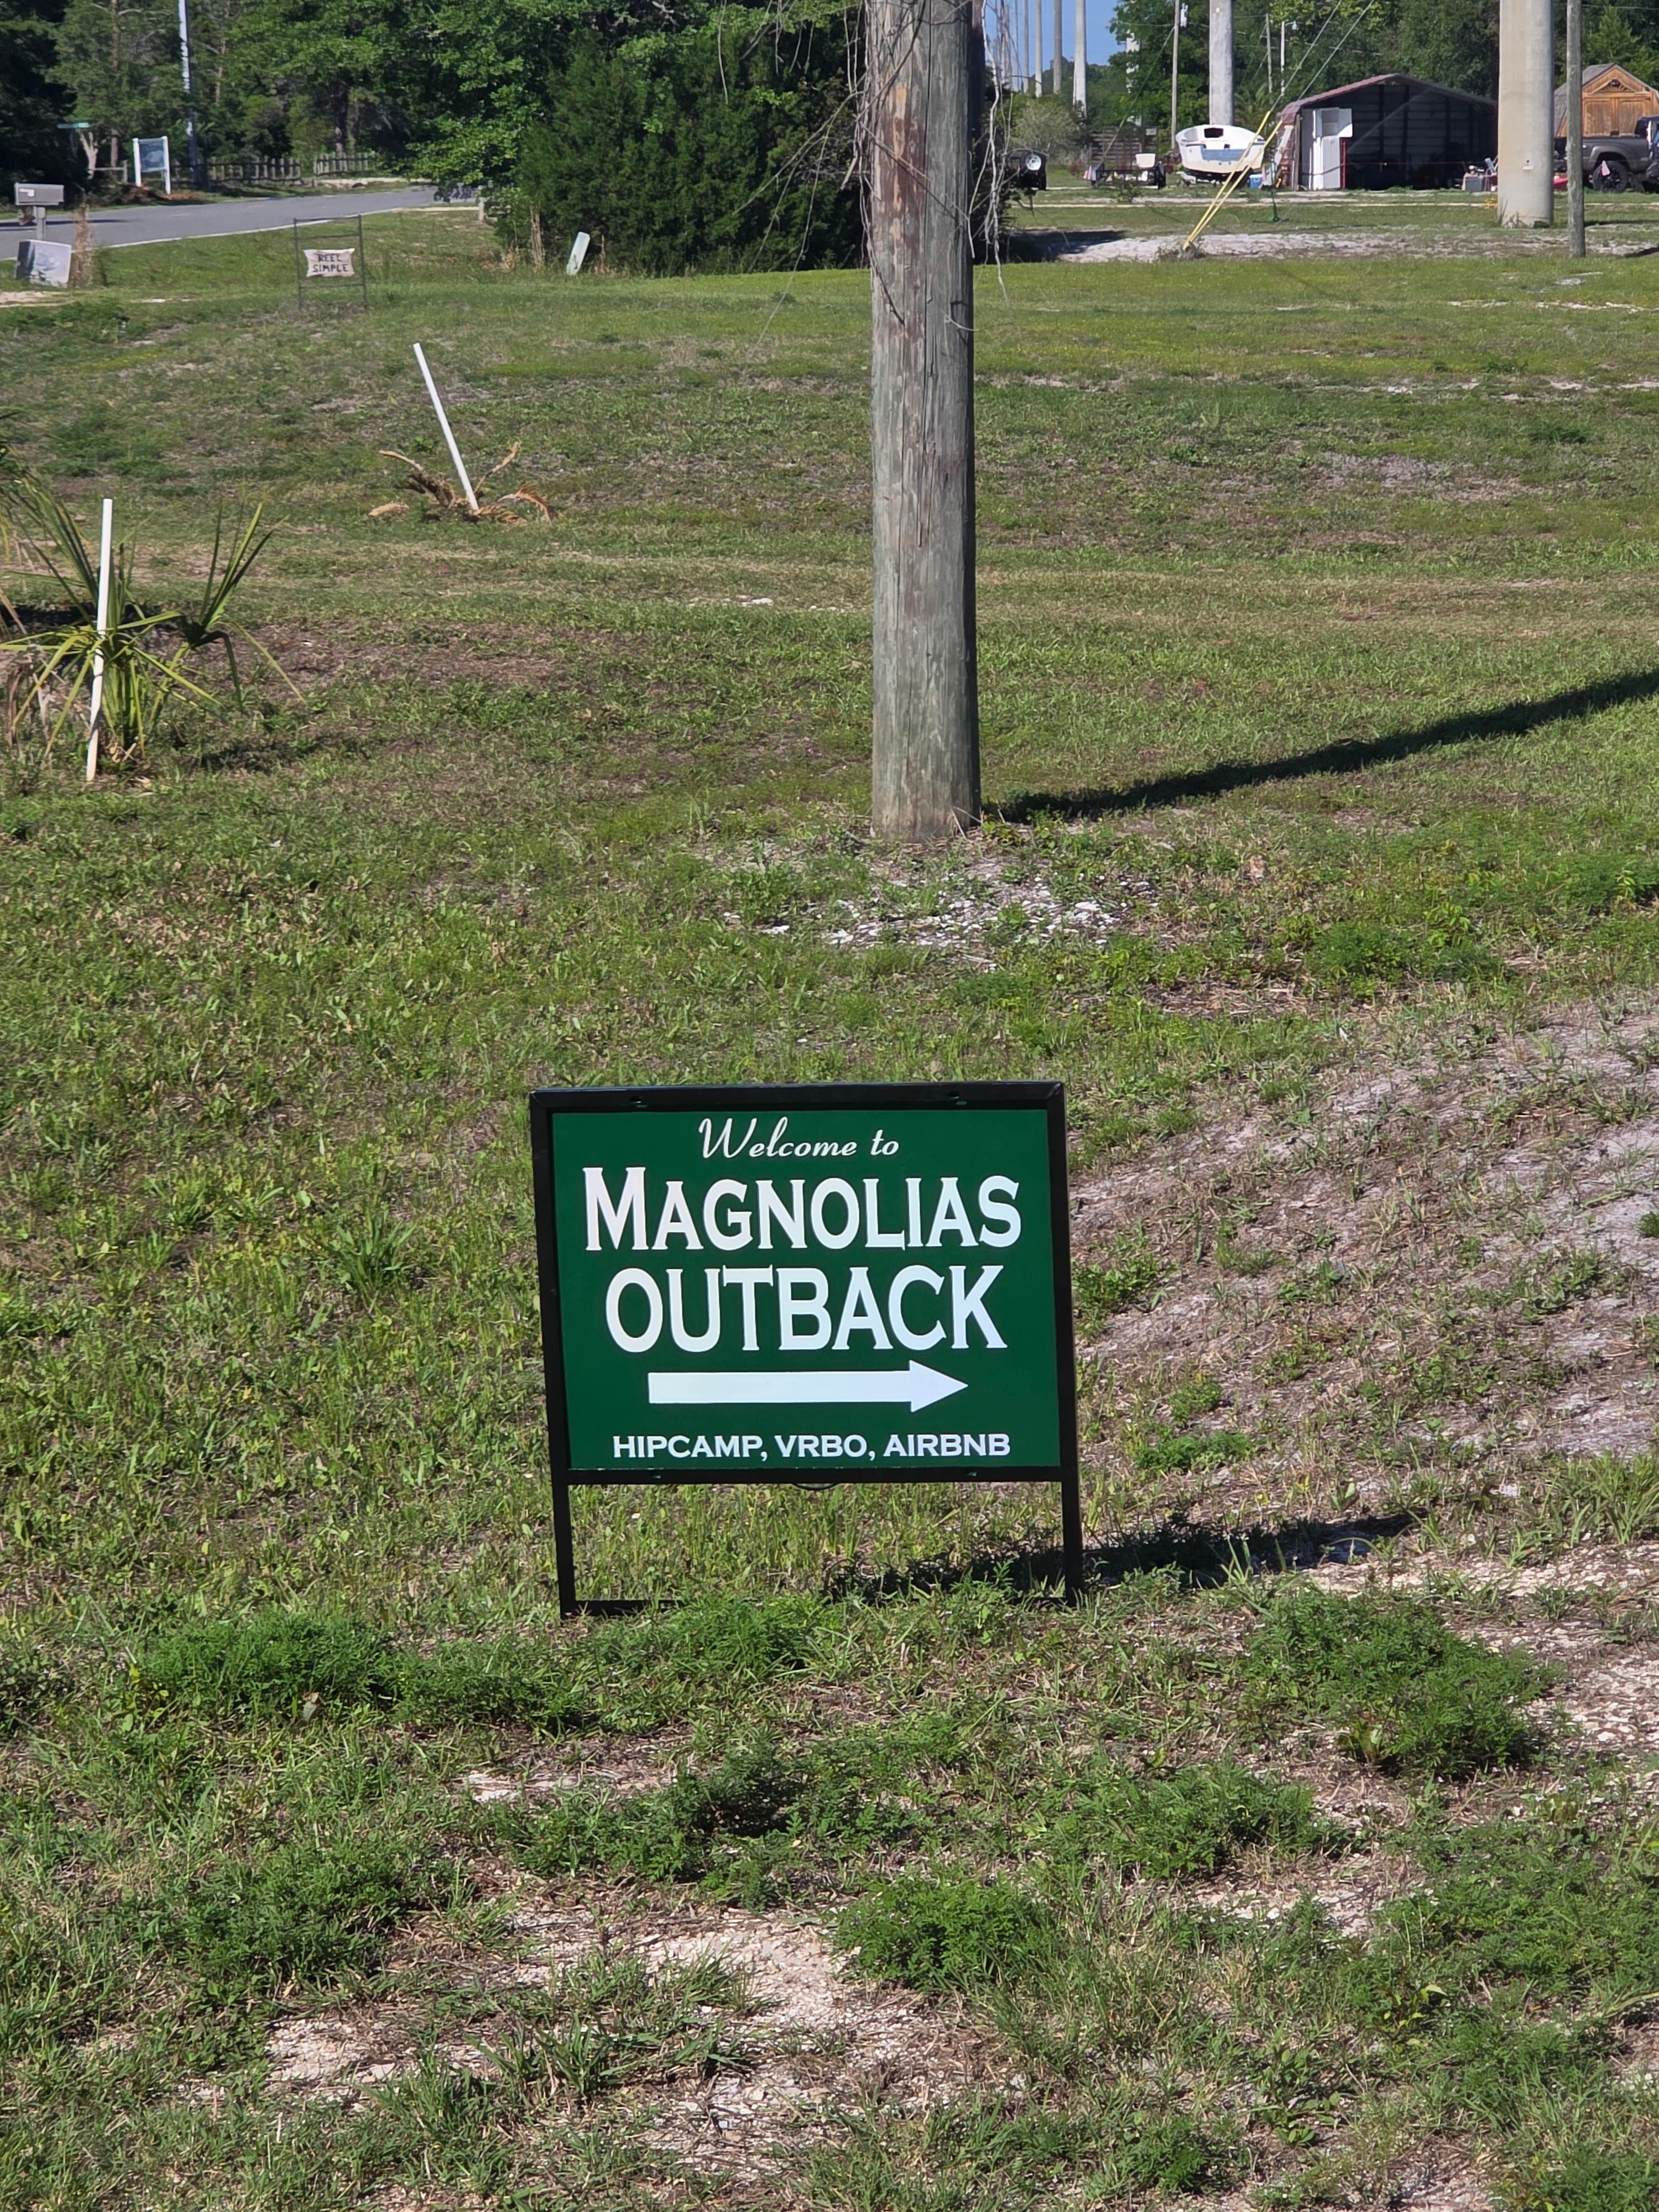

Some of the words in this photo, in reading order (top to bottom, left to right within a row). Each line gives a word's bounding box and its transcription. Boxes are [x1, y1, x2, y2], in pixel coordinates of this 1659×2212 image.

[312, 264, 348, 272] SIMPLE
[698, 1117, 857, 1159] Welcome
[870, 1129, 899, 1156] to
[582, 1167, 1021, 1251] MAGNOLIAS
[606, 1264, 1008, 1353] OUTBACK
[613, 1435, 768, 1462] HIPCAMP,
[774, 1434, 875, 1461] VRBO,
[883, 1433, 1010, 1457] AIRBNB
